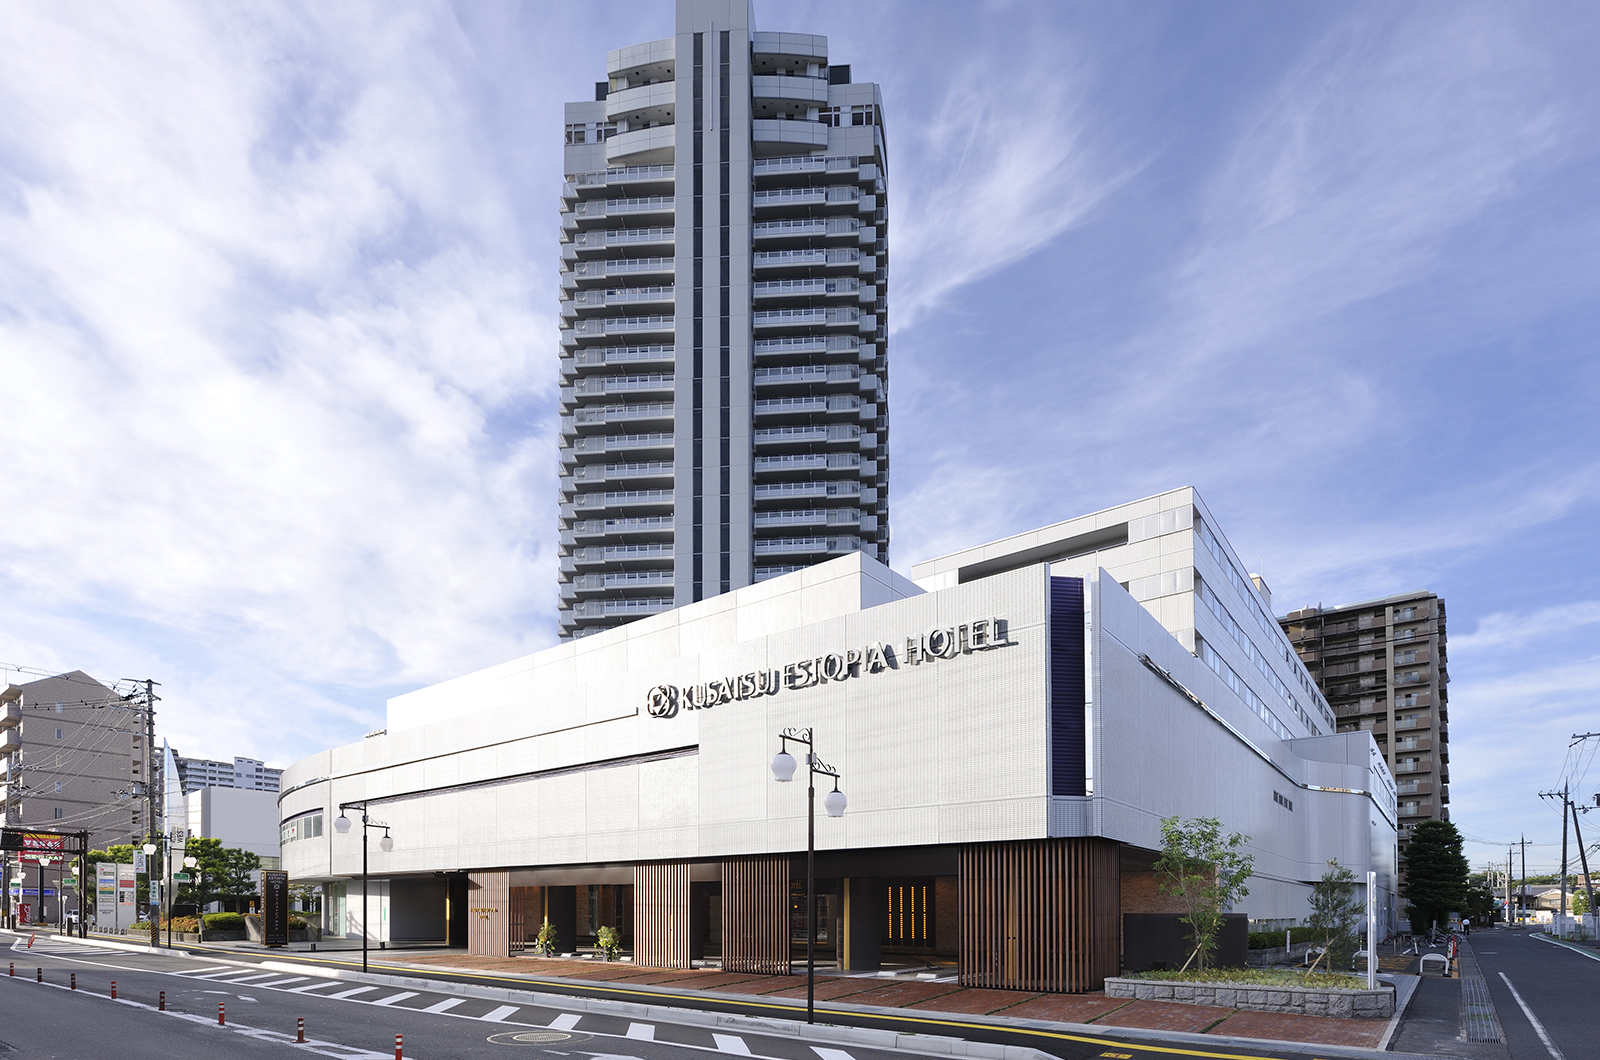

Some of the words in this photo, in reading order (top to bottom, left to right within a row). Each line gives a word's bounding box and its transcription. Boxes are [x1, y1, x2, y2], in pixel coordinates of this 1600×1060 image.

[682, 667, 774, 709] KUSATSU
[783, 641, 889, 688] ESTOPIA
[902, 616, 1007, 663] HOTEL
[176, 826, 184, 844] WEST
